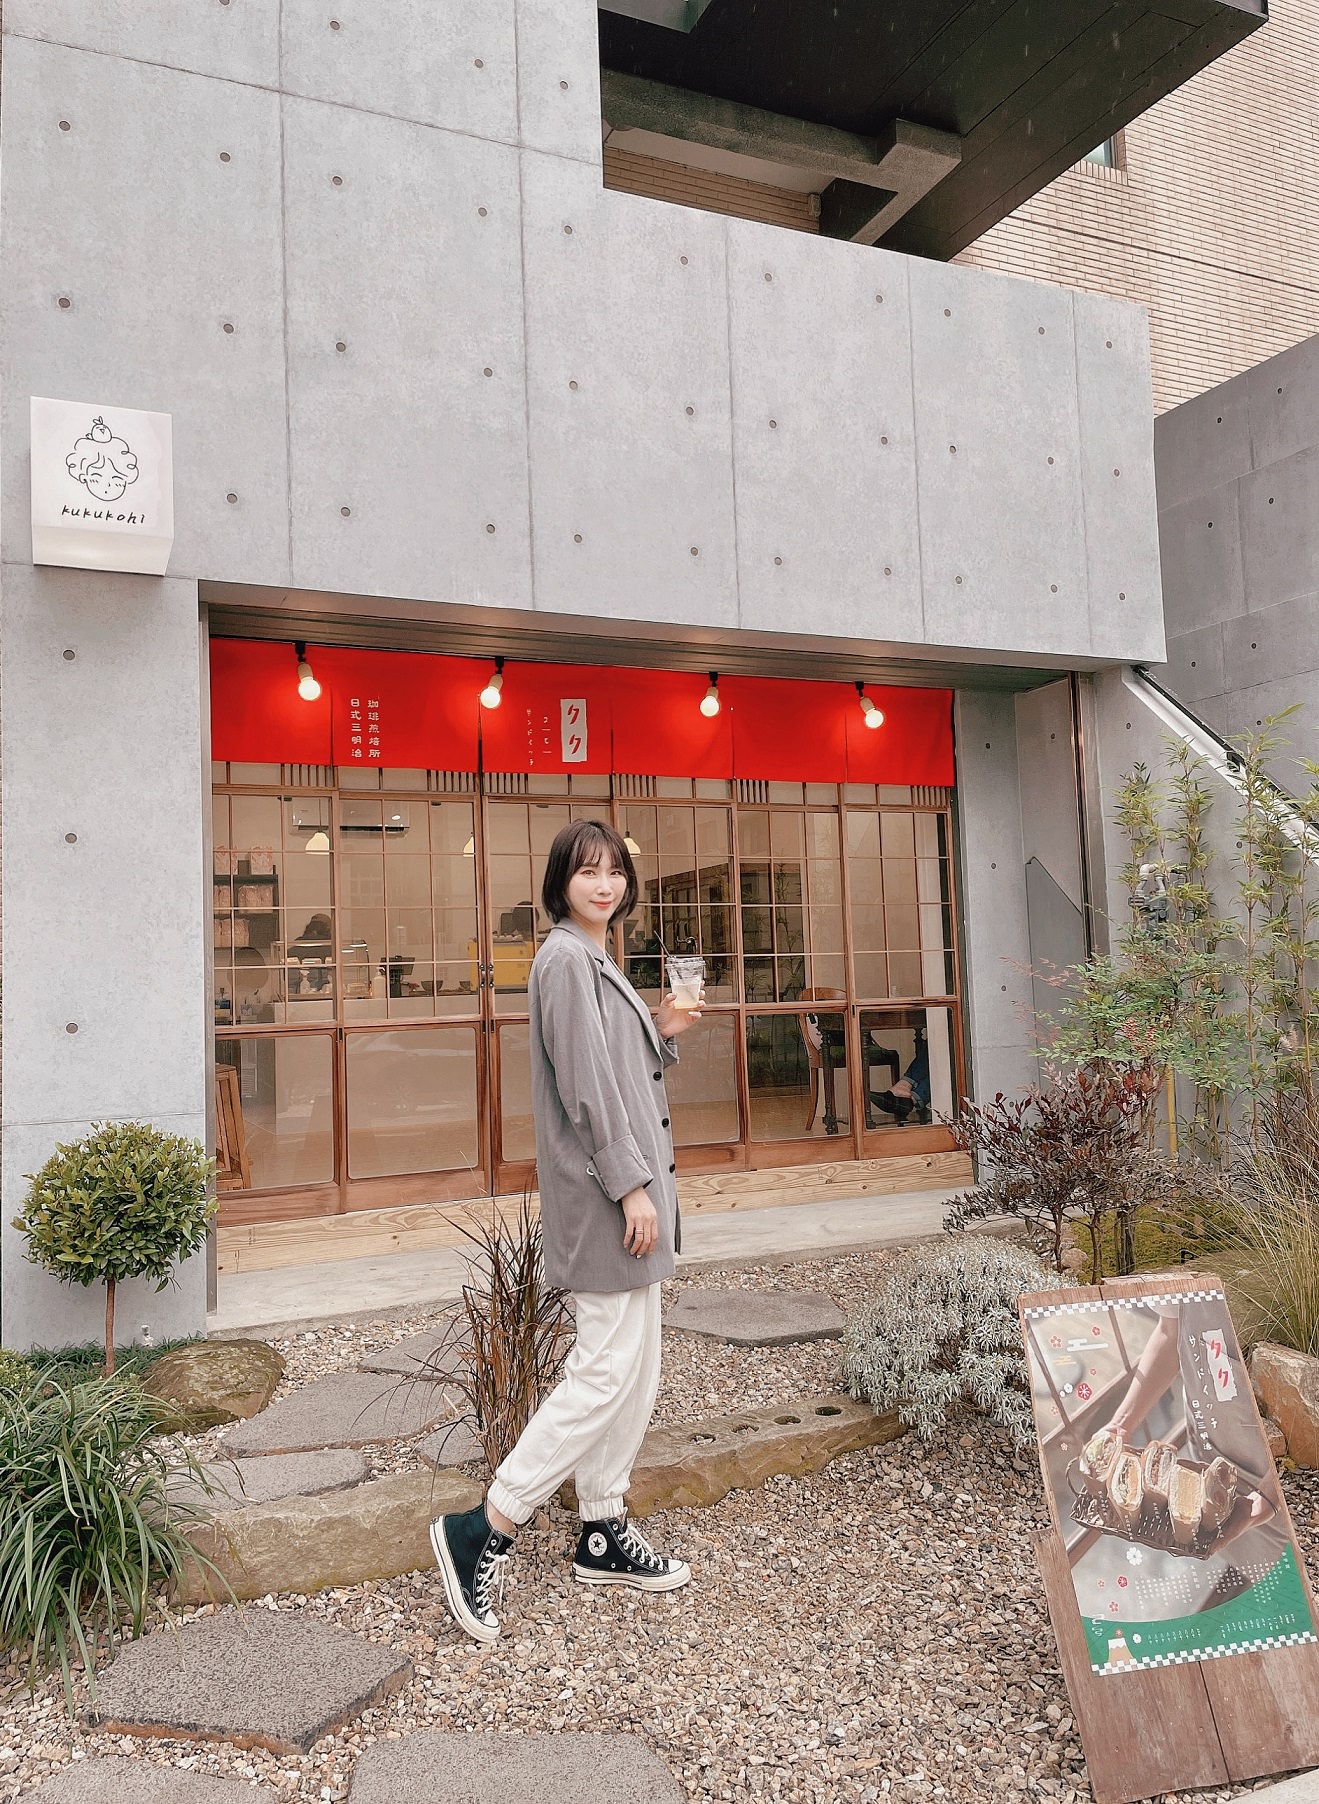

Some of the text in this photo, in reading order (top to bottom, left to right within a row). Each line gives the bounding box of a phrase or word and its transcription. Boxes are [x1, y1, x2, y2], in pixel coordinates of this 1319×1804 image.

[61, 505, 146, 524] kukukohi
[350, 698, 363, 758] 日式三明治
